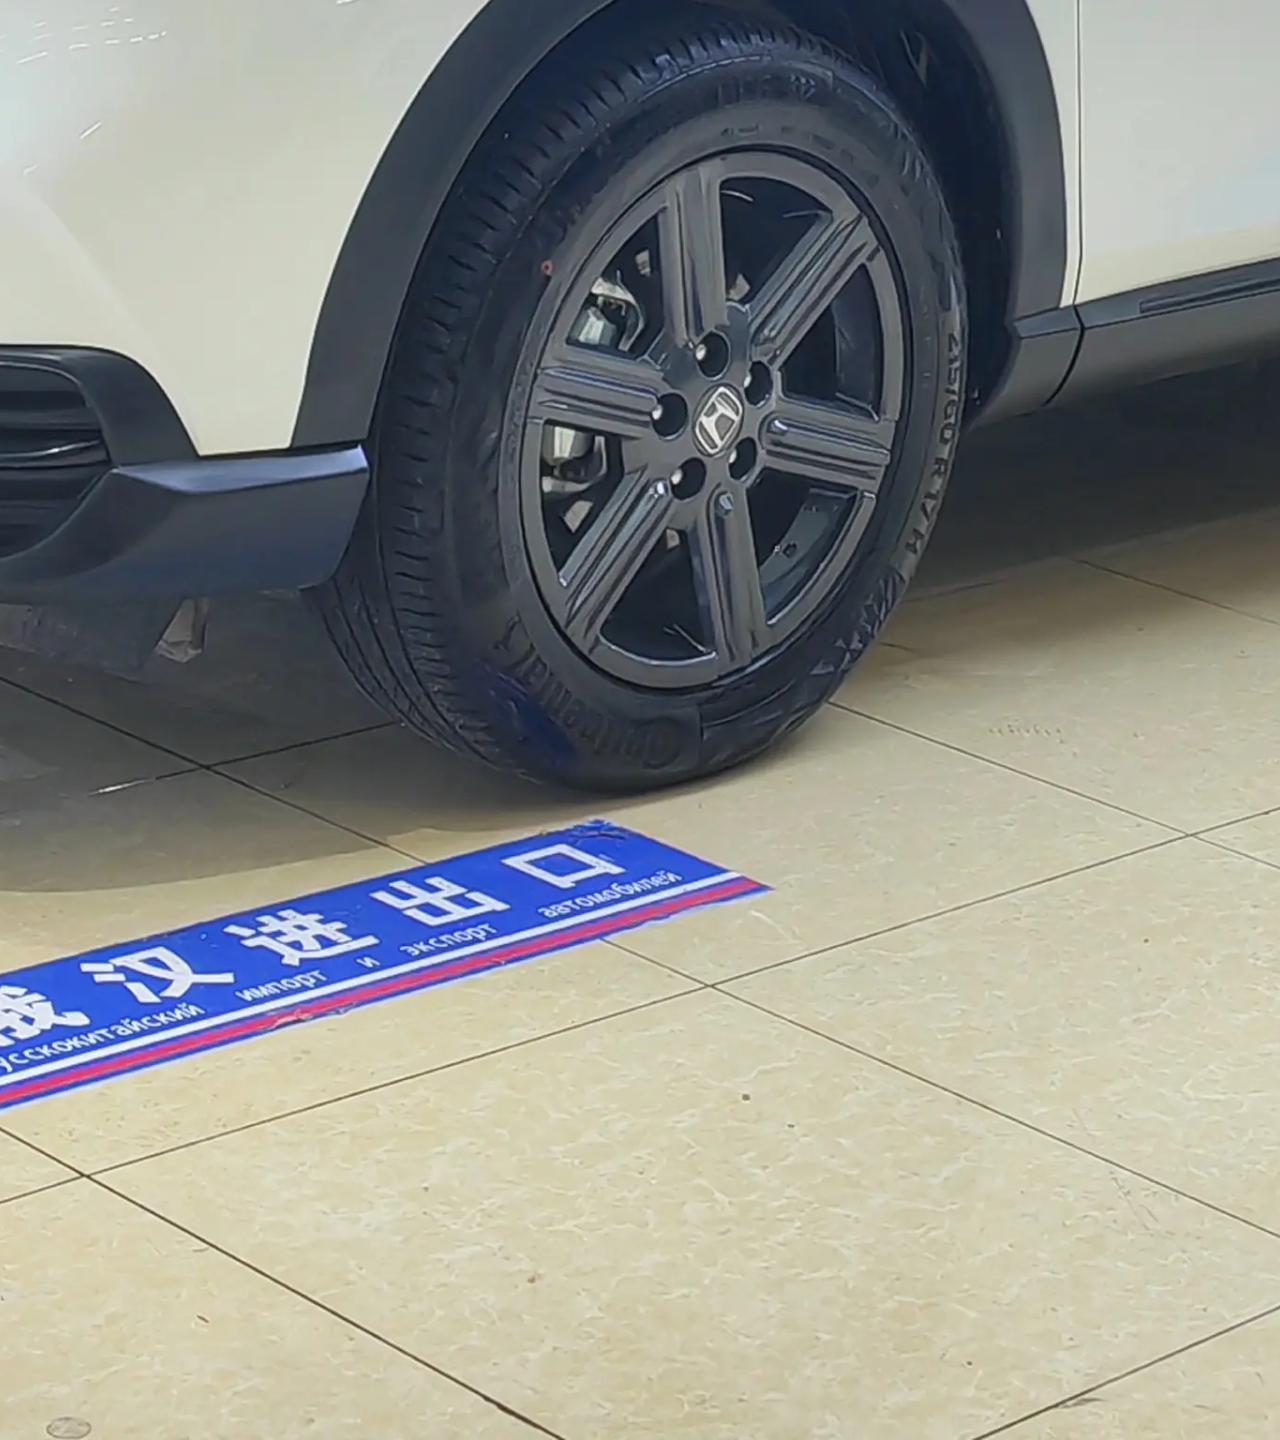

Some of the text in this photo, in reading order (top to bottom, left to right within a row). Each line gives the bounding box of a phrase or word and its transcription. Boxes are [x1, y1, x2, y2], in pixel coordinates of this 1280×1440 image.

[233, 968, 328, 1003] импорт
[357, 956, 381, 970] и
[398, 922, 498, 957] экспорт
[537, 869, 683, 920] автомобилей
